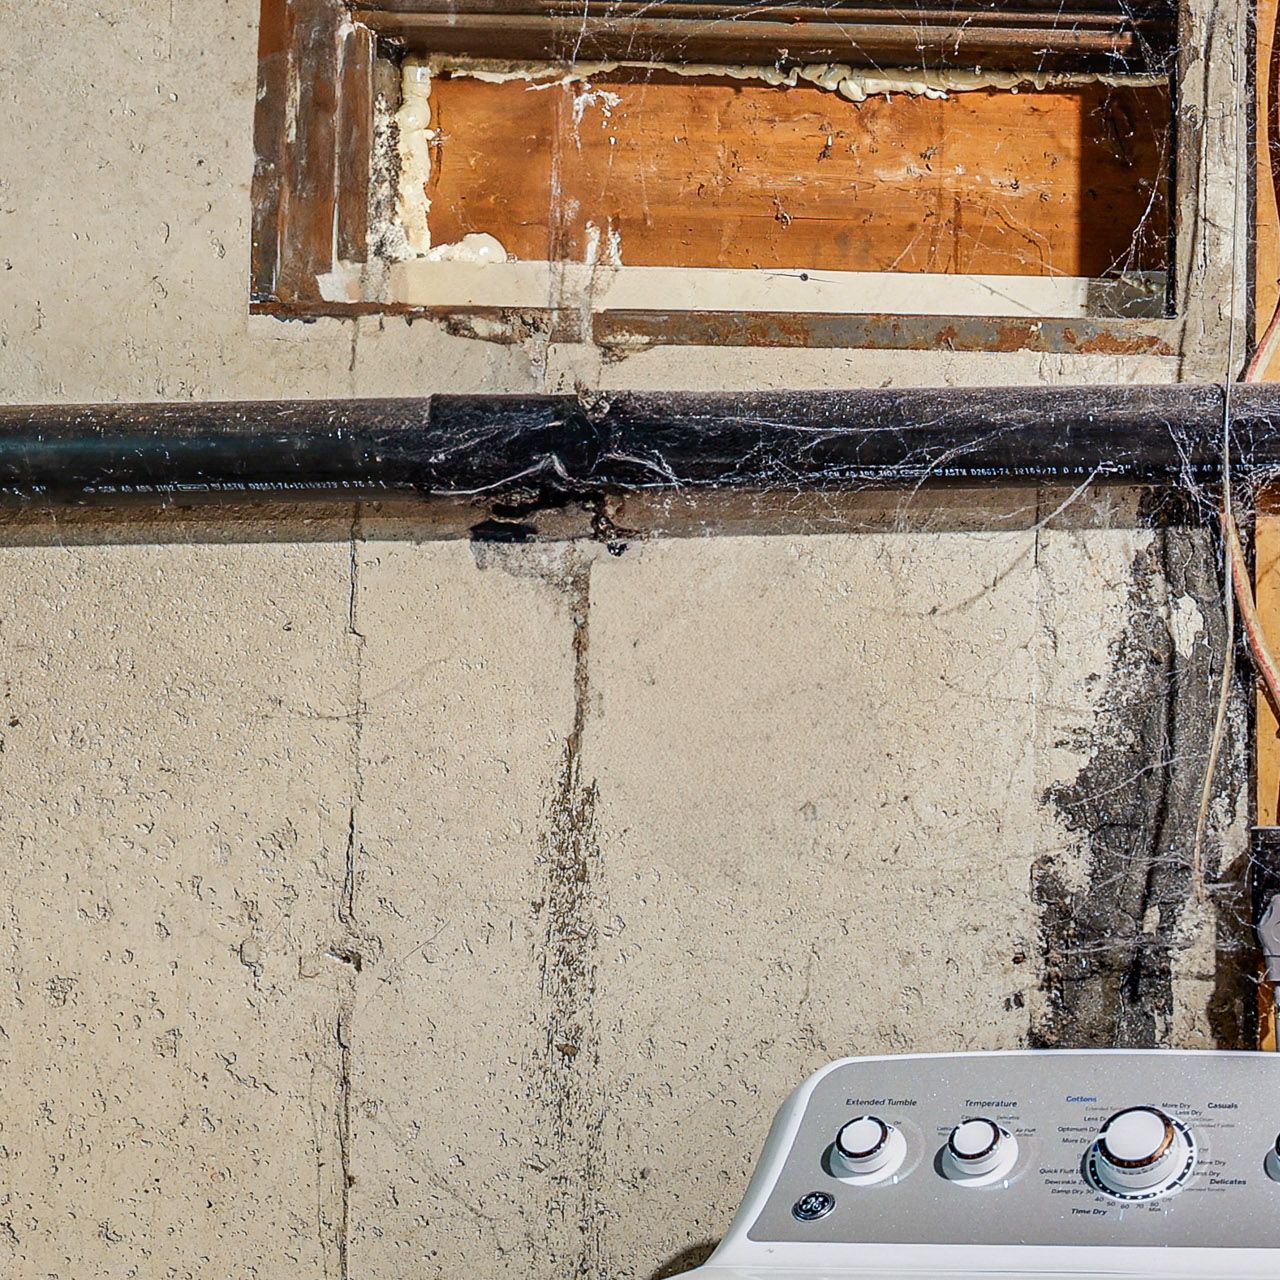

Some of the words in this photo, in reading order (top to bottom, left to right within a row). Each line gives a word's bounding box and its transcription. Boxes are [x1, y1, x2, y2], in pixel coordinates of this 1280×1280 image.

[846, 1098, 885, 1106] Extended
[888, 1098, 917, 1106] Tumble
[965, 1100, 1018, 1108] Temperature
[1093, 1208, 1108, 1216] Dry
